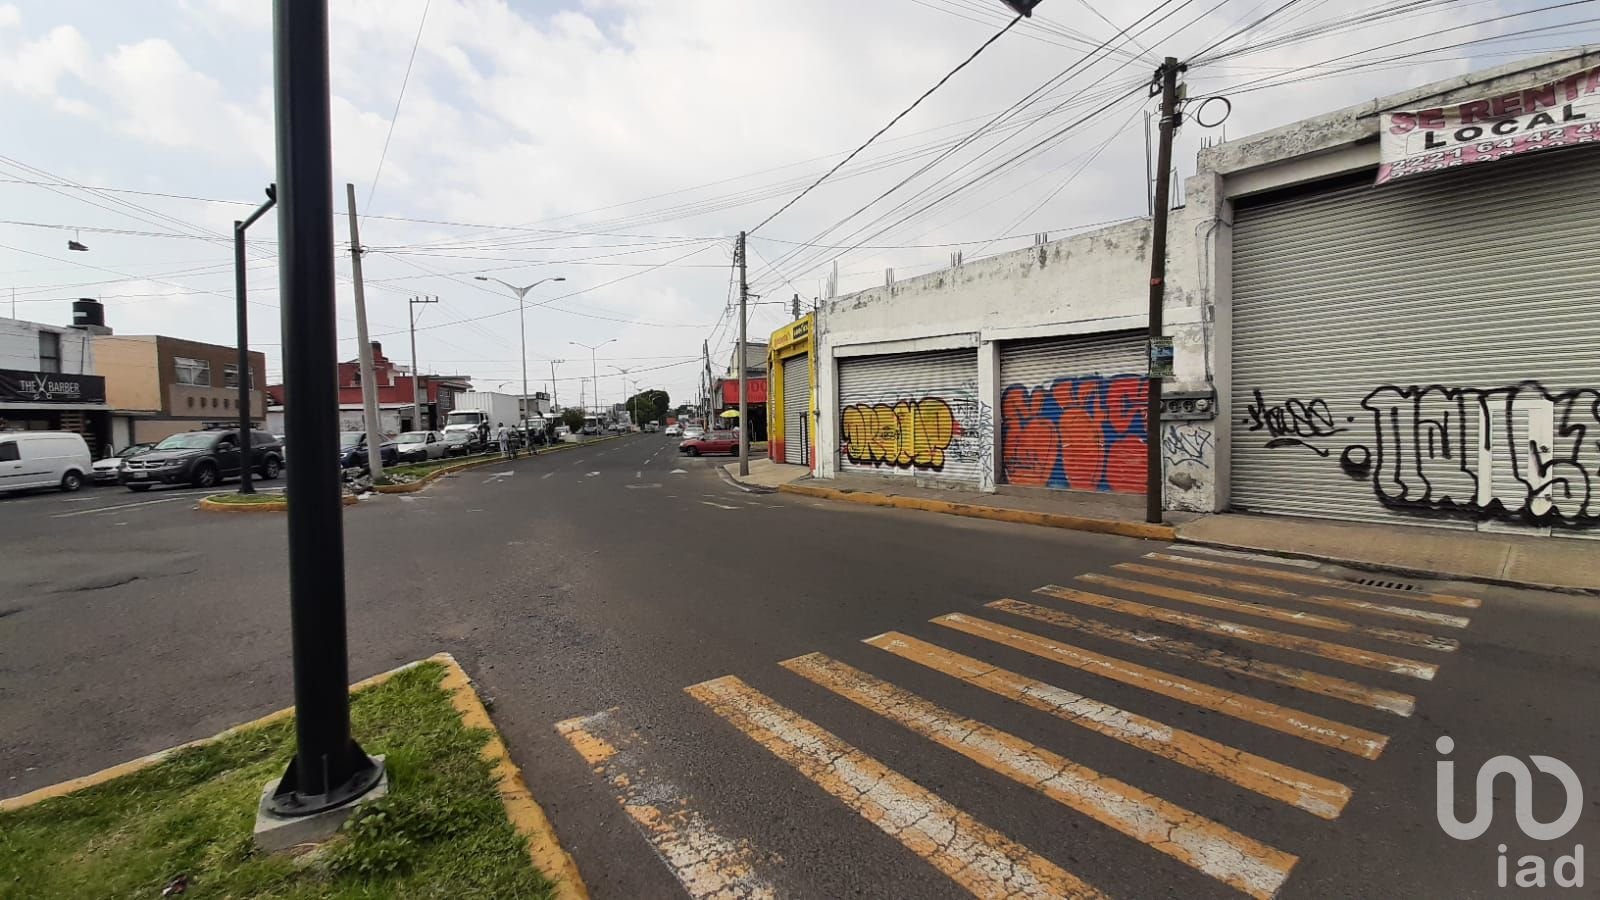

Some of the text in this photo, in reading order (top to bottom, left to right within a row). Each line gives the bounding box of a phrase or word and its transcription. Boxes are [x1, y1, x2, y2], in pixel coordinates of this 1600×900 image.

[1389, 108, 1446, 135] SE
[1425, 103, 1586, 151] LOCAL
[1391, 147, 1463, 172] 2221
[1476, 137, 1516, 153] 64
[1527, 128, 1565, 143] 42
[1576, 122, 1600, 135] 4
[19, 380, 80, 393] THE BARBER
